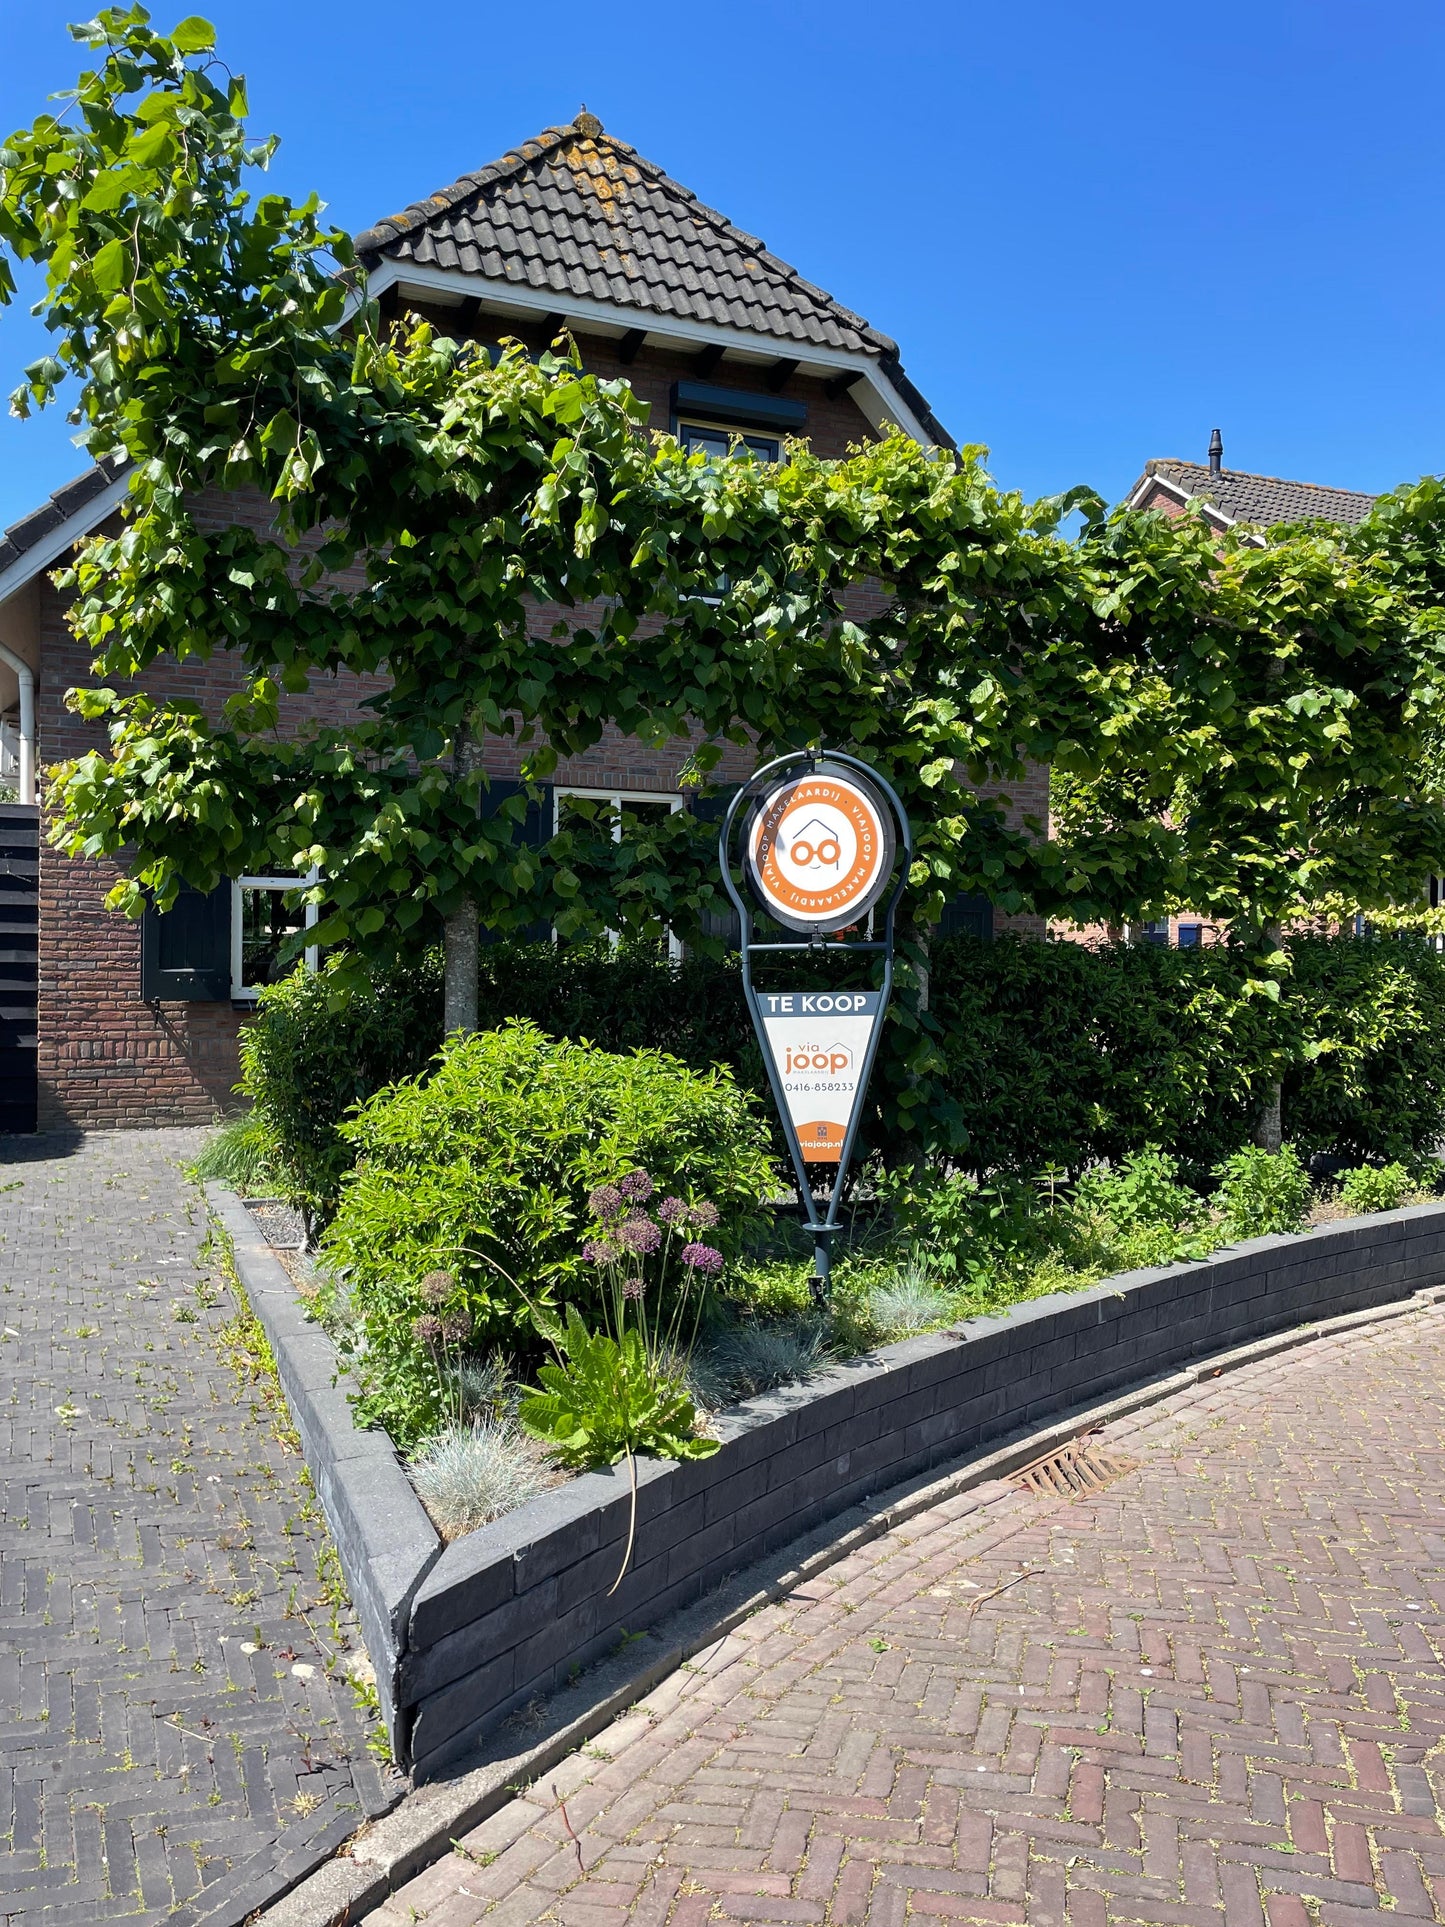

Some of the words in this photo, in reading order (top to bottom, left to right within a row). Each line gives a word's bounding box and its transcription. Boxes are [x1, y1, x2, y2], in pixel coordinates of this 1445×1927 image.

[767, 788, 841, 829] MAKELAARDIJ
[852, 806, 871, 861] VIAJOOP
[762, 835, 780, 888] VIAJOOP
[790, 868, 866, 906] MAKELAARDIJ
[768, 997, 793, 1012] TE
[802, 996, 866, 1011] KOOP
[785, 1047, 848, 1075] joop
[798, 1042, 820, 1052] via
[785, 1083, 854, 1092] 0416-858233
[800, 1139, 843, 1149] viajoop.nl
